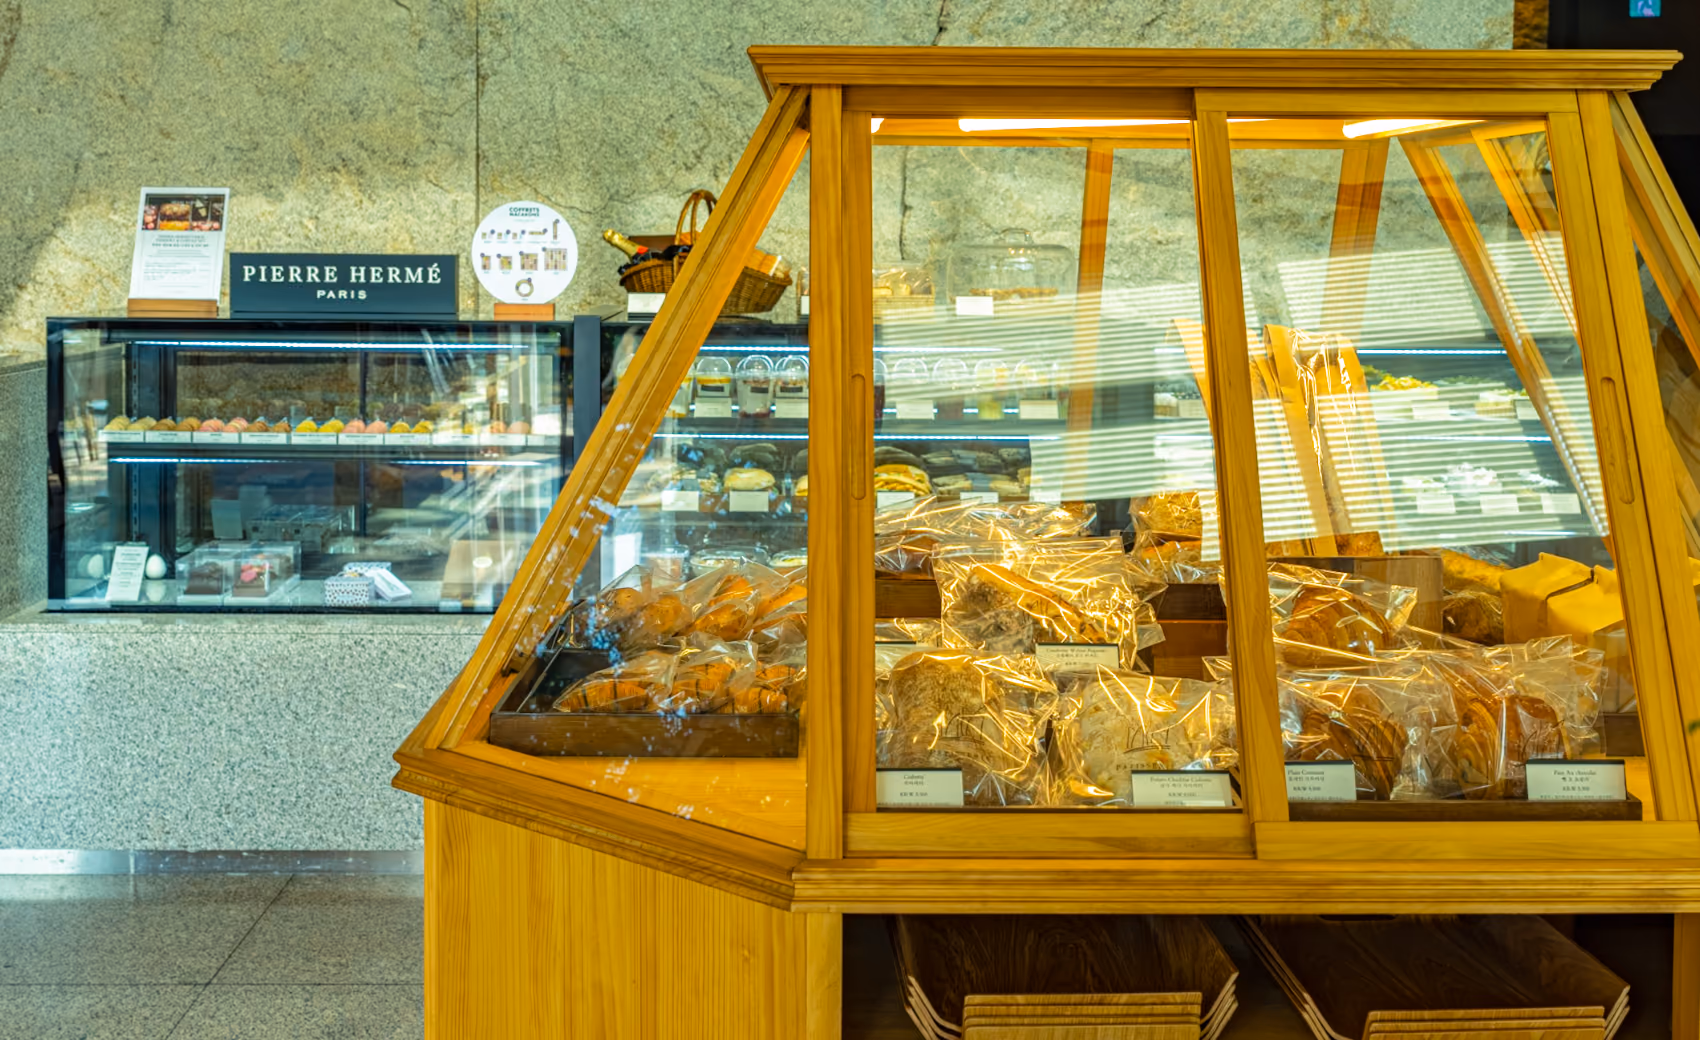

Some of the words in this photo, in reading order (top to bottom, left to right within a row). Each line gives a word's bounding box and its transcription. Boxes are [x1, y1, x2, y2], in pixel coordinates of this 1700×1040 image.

[243, 265, 338, 283] PIERRE
[350, 263, 442, 284] HERMÉ
[317, 289, 367, 300] PARIS
